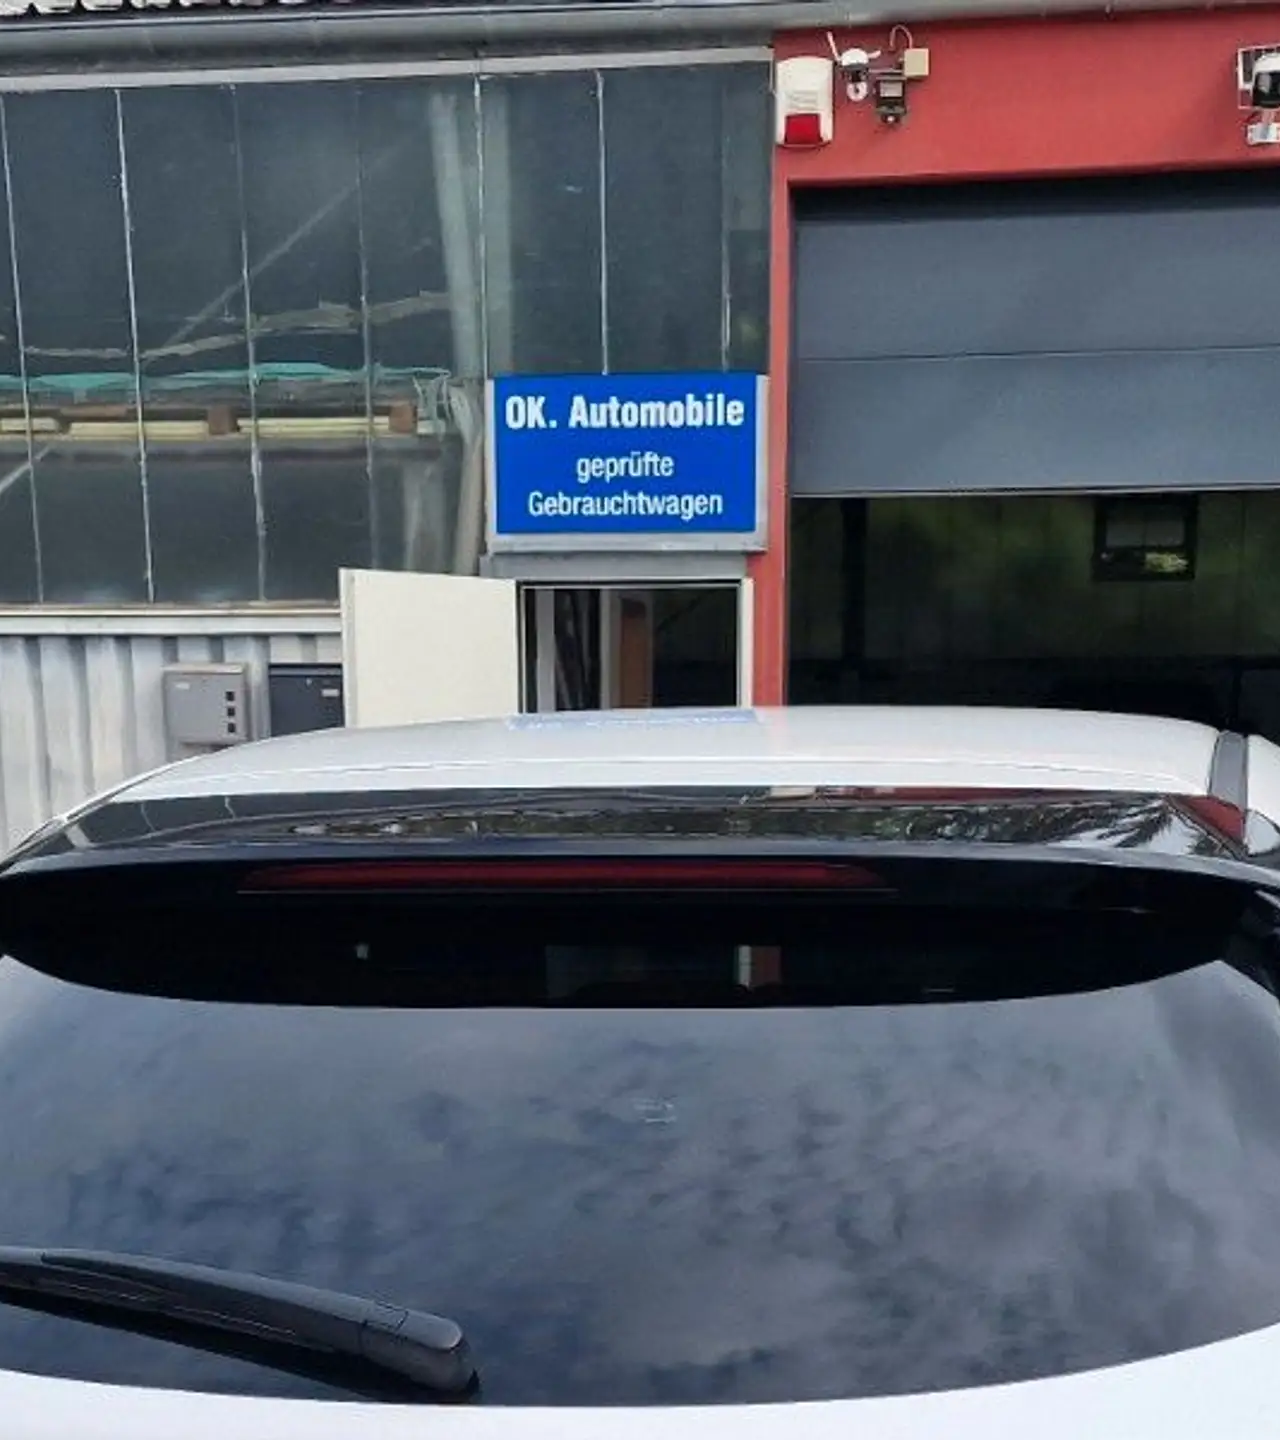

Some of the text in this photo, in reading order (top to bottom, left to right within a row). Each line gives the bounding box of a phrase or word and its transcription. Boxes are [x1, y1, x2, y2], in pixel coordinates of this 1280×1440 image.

[505, 393, 744, 428] OK. Automobile
[576, 450, 674, 483] geprüfte
[528, 491, 723, 521] Gebrauchtwagen
